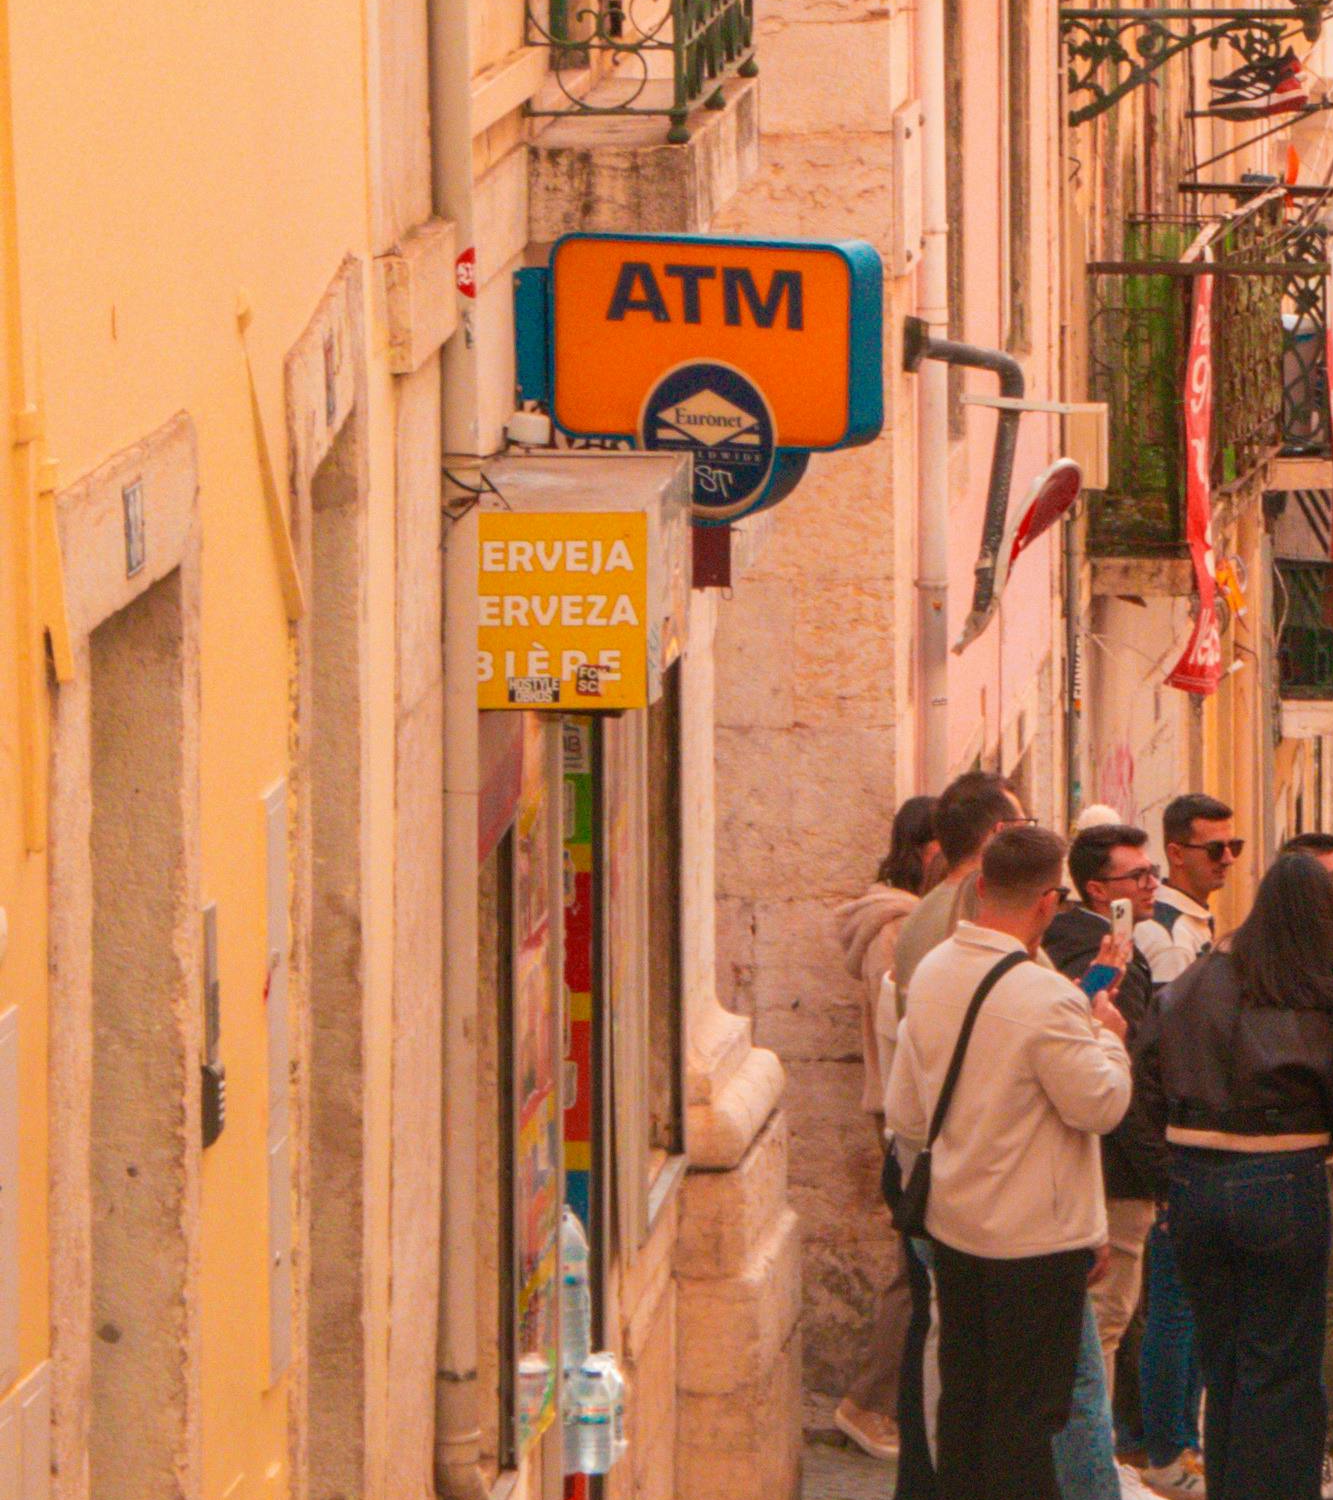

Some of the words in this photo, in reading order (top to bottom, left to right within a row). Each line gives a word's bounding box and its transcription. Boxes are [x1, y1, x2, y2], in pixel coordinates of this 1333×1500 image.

[606, 262, 804, 331] ATM
[674, 407, 742, 428] Euronet
[697, 451, 762, 464] LDWIDE
[478, 540, 634, 575] ERVEJA
[478, 595, 640, 627] ERVEZA
